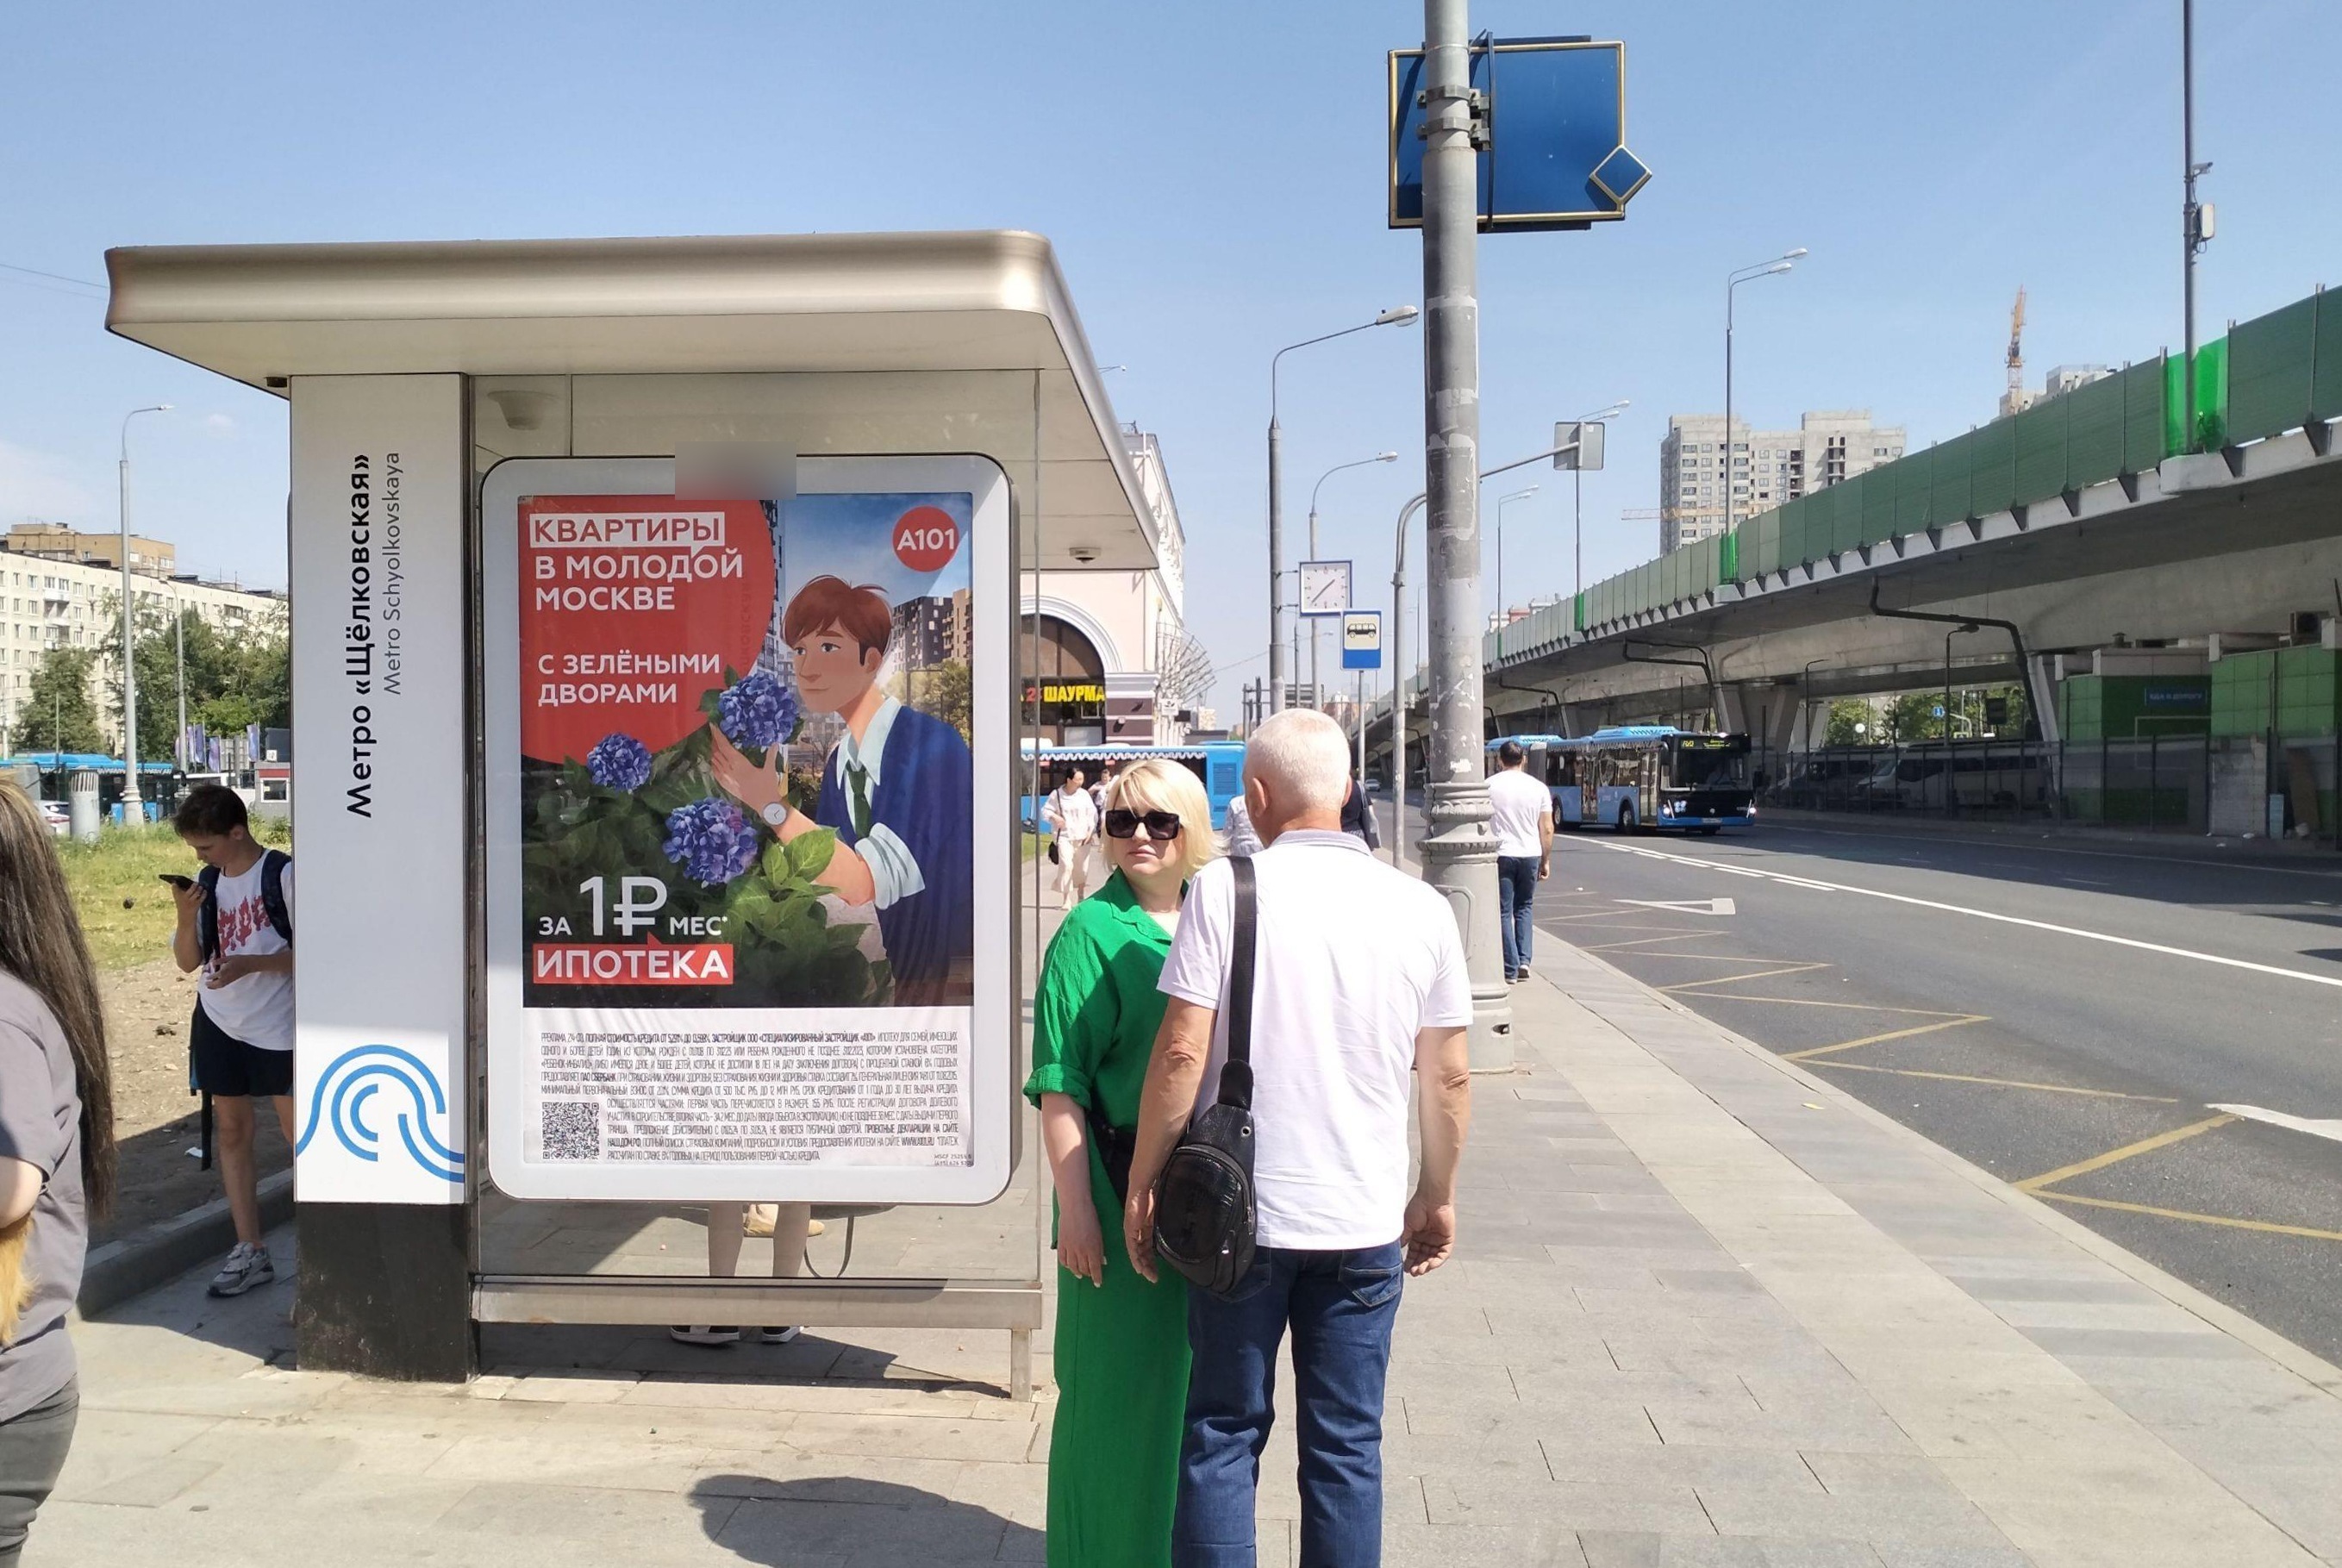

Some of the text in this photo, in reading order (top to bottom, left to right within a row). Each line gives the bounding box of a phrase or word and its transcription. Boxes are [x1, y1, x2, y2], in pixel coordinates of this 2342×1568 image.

[534, 518, 719, 542] КВАРТИРЫ
[381, 452, 404, 695] Metro Schyolkovskaya
[535, 547, 742, 583] В МОЛОДОЙ
[536, 586, 675, 610] МОСКВЕ
[346, 454, 377, 818] Метро «Щёлковская»
[538, 649, 720, 674] С ЗЕЛЁНЫМИ
[538, 684, 677, 707] ДВОРАМИ
[1044, 685, 1105, 703] ШАУРМА
[539, 916, 572, 936] ЗА
[537, 949, 729, 979] ИПОТЕКА
